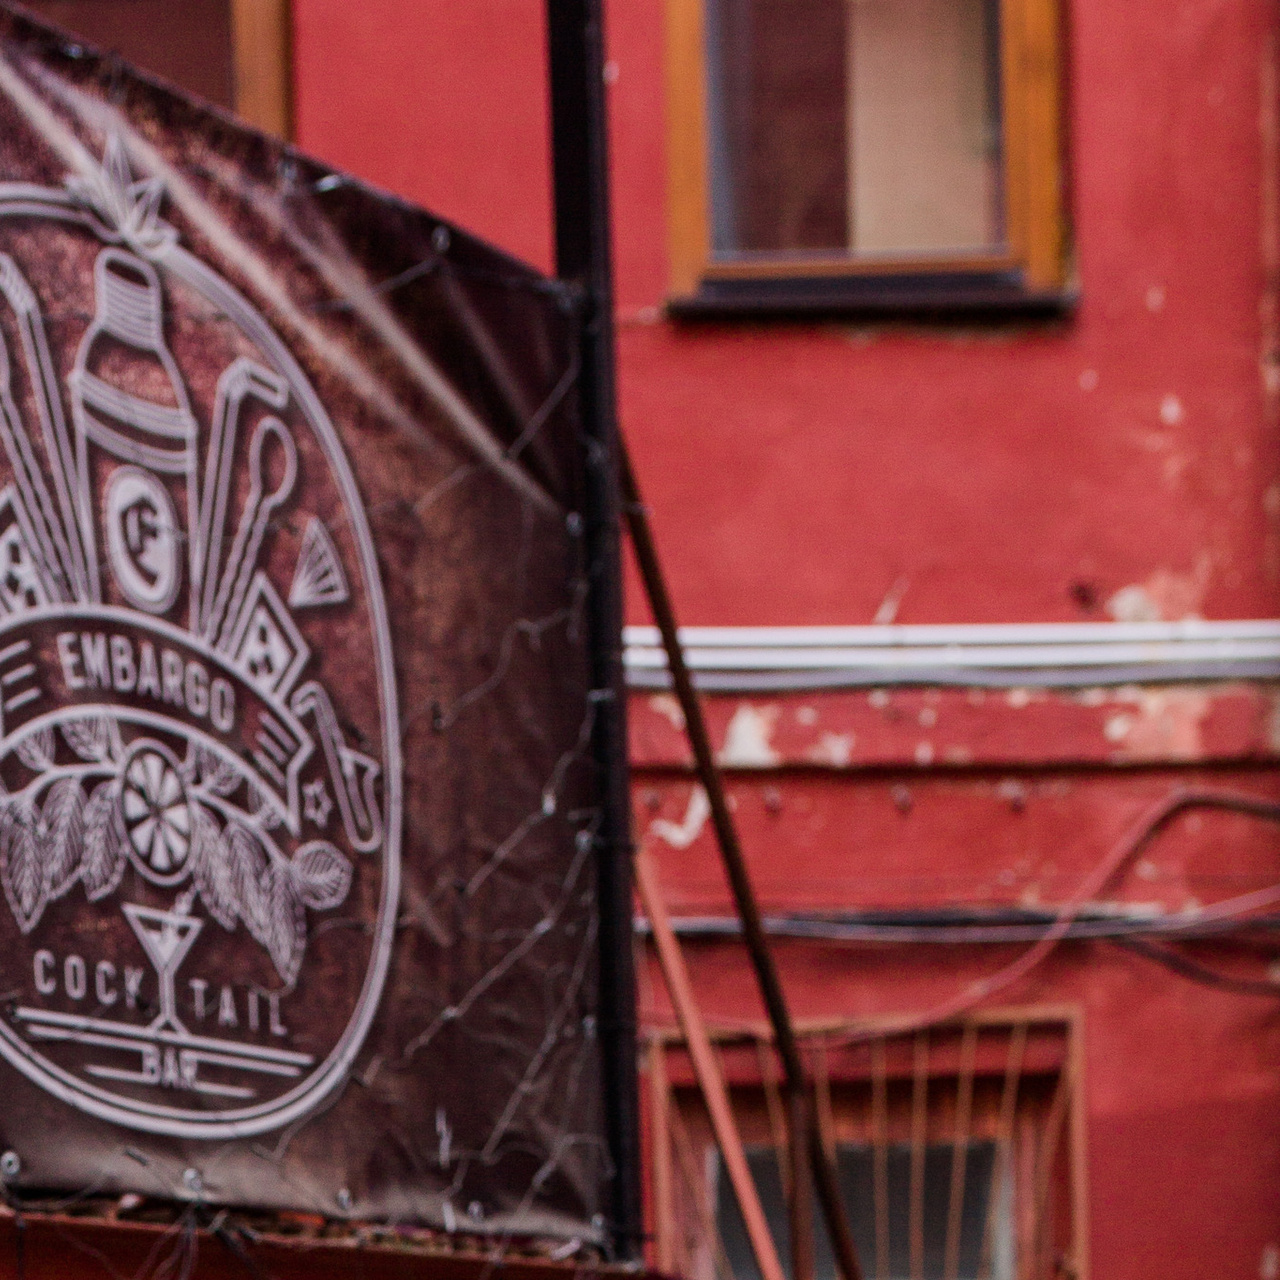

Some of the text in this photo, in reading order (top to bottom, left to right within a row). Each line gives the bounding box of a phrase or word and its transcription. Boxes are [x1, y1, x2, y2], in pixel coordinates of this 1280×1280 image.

[56, 631, 236, 733] EMBARGO
[33, 949, 287, 1036] COCK TAIL
[141, 1045, 198, 1089] BAR
